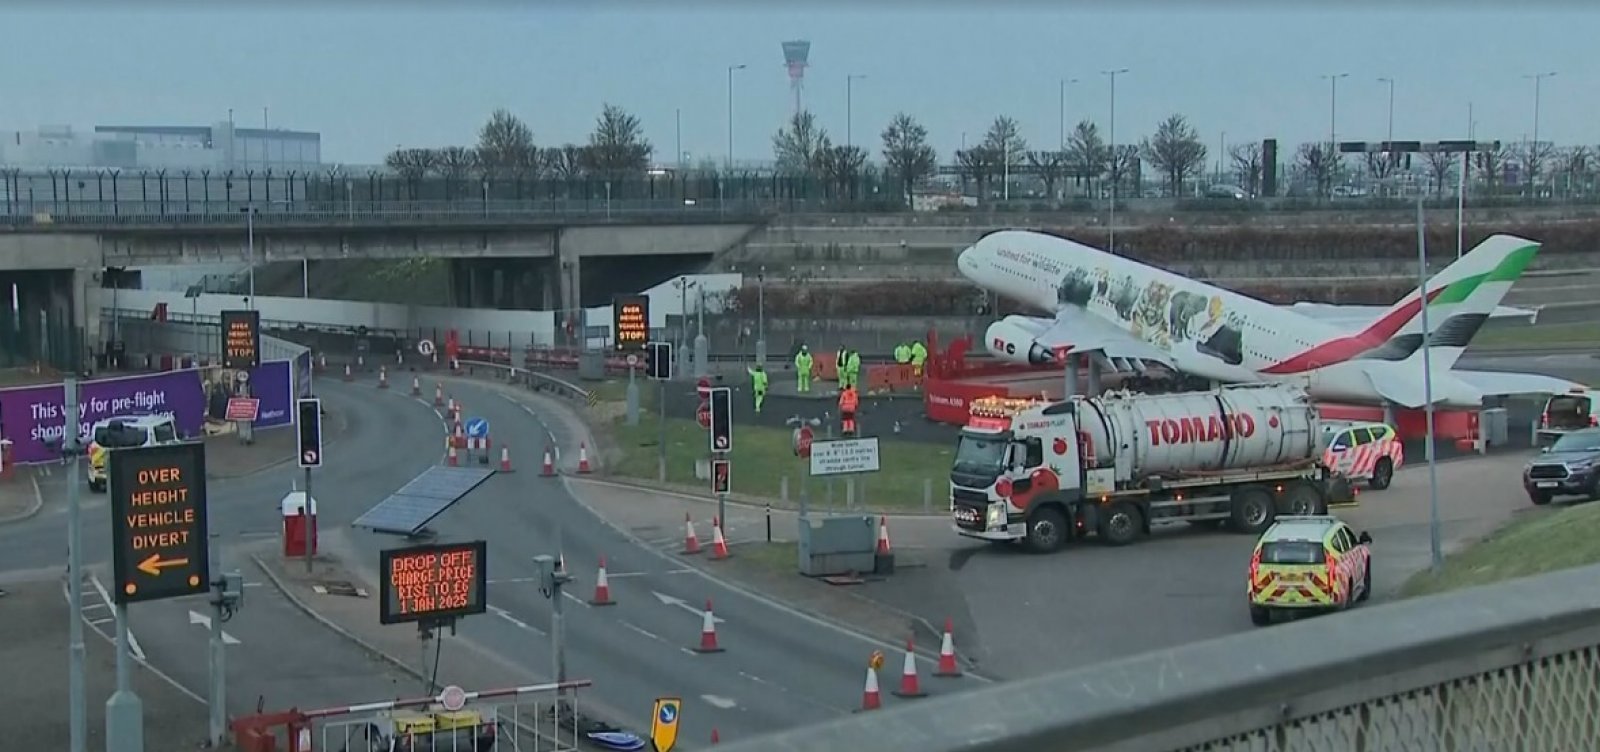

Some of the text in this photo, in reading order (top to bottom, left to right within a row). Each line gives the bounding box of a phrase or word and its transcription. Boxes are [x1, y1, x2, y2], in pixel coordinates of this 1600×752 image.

[231, 322, 249, 330] OVER
[227, 339, 253, 347] VEHICLE
[31, 402, 58, 420] This
[91, 397, 109, 414] for
[112, 390, 165, 412] pre-flight
[1145, 412, 1255, 446] TOMATO
[138, 467, 180, 485] OVER
[132, 488, 188, 507] HEIGHT
[127, 509, 195, 529] VEHICLE
[133, 531, 189, 549] DIVERT
[393, 550, 473, 573] DROP OFF
[391, 564, 475, 586] CHARGE PRICE
[399, 583, 430, 600] RISE
[433, 581, 449, 596] TO
[401, 592, 468, 614] 1 JAN 2025
